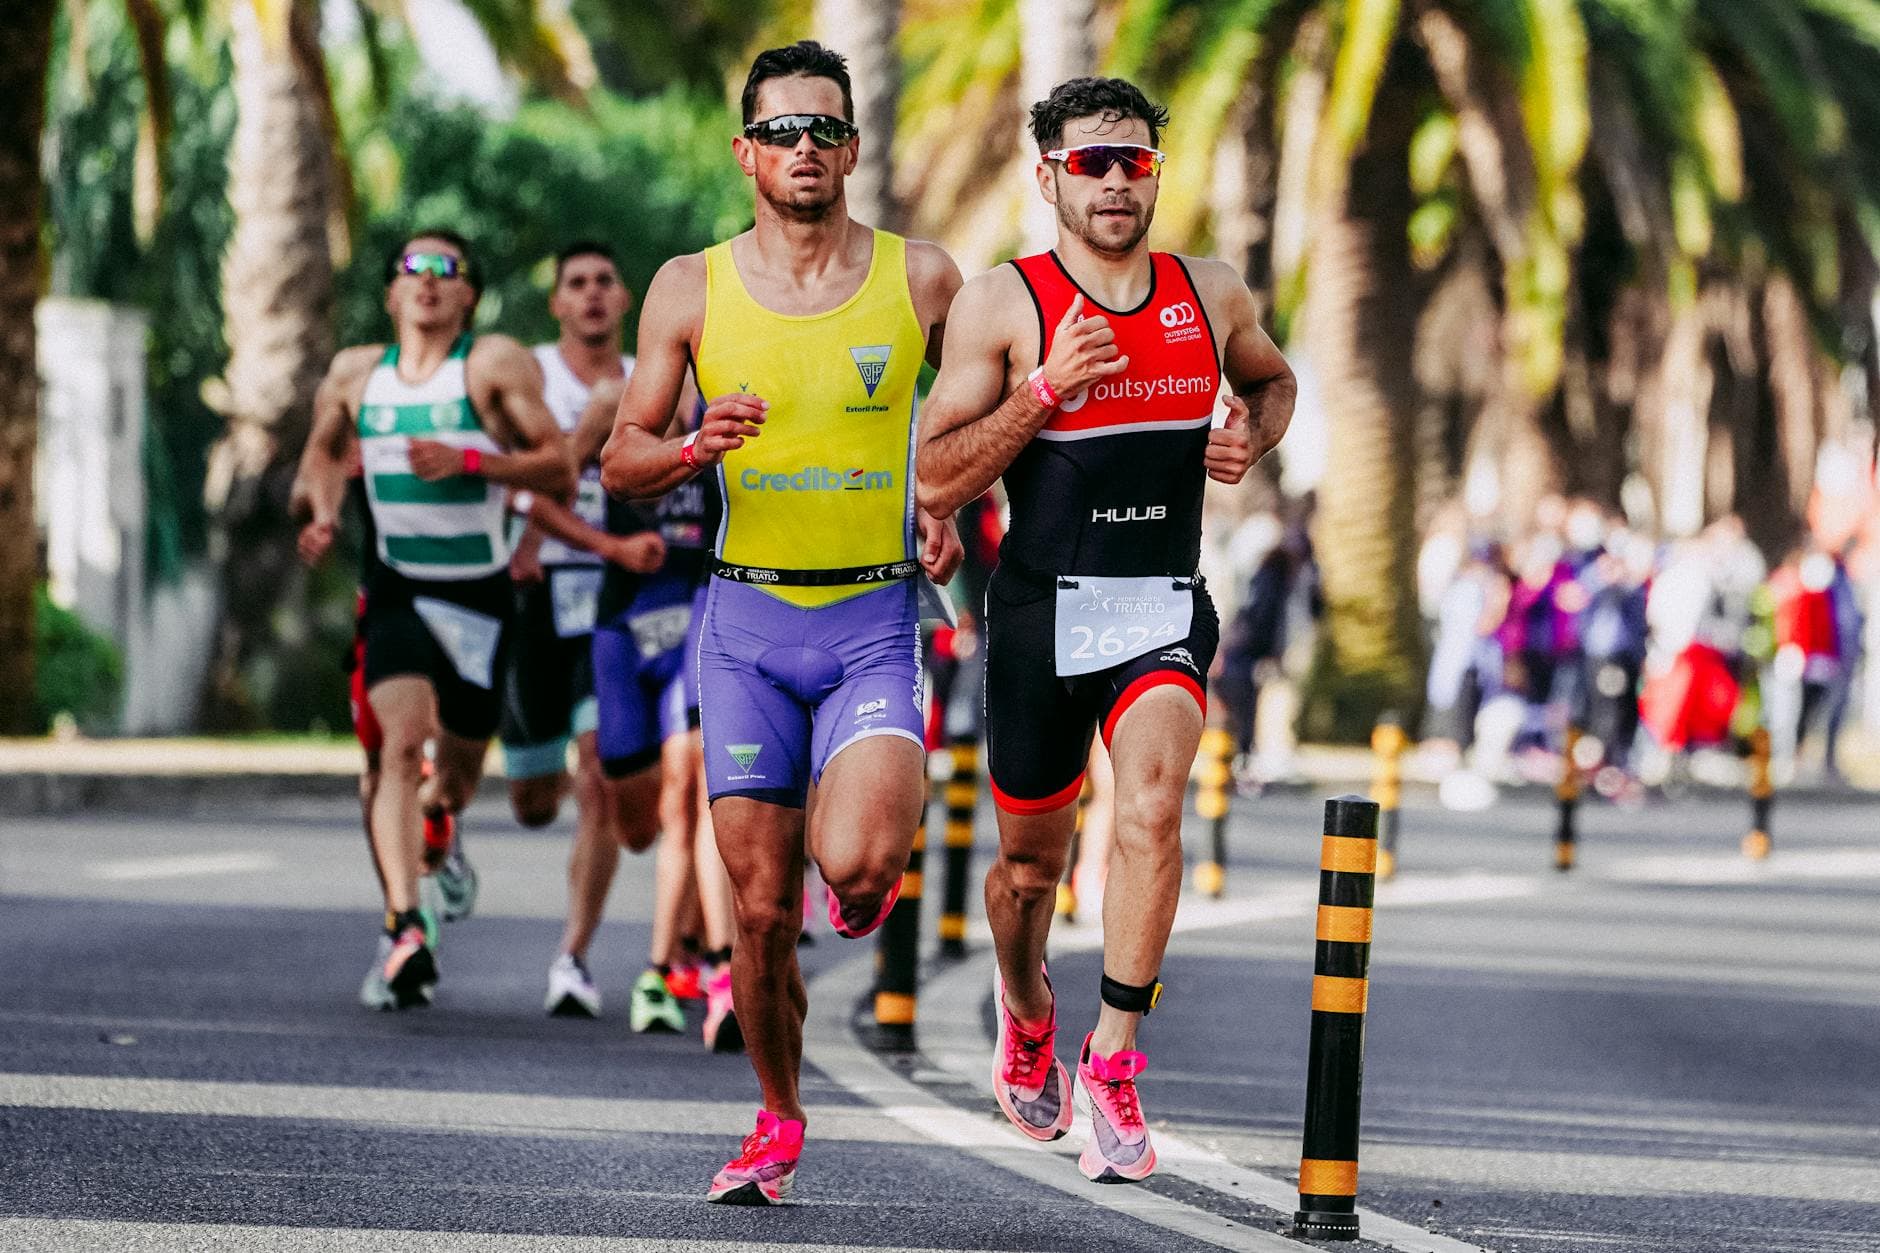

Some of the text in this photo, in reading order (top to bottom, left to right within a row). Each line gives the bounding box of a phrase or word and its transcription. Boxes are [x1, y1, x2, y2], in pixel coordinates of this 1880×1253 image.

[1094, 374, 1211, 402] outsystems
[845, 405, 870, 413] Estoril
[740, 467, 893, 491] Credibom
[1092, 506, 1167, 523] HUUB
[746, 571, 779, 582] TRIATLO
[1114, 602, 1165, 613] TRIATLO
